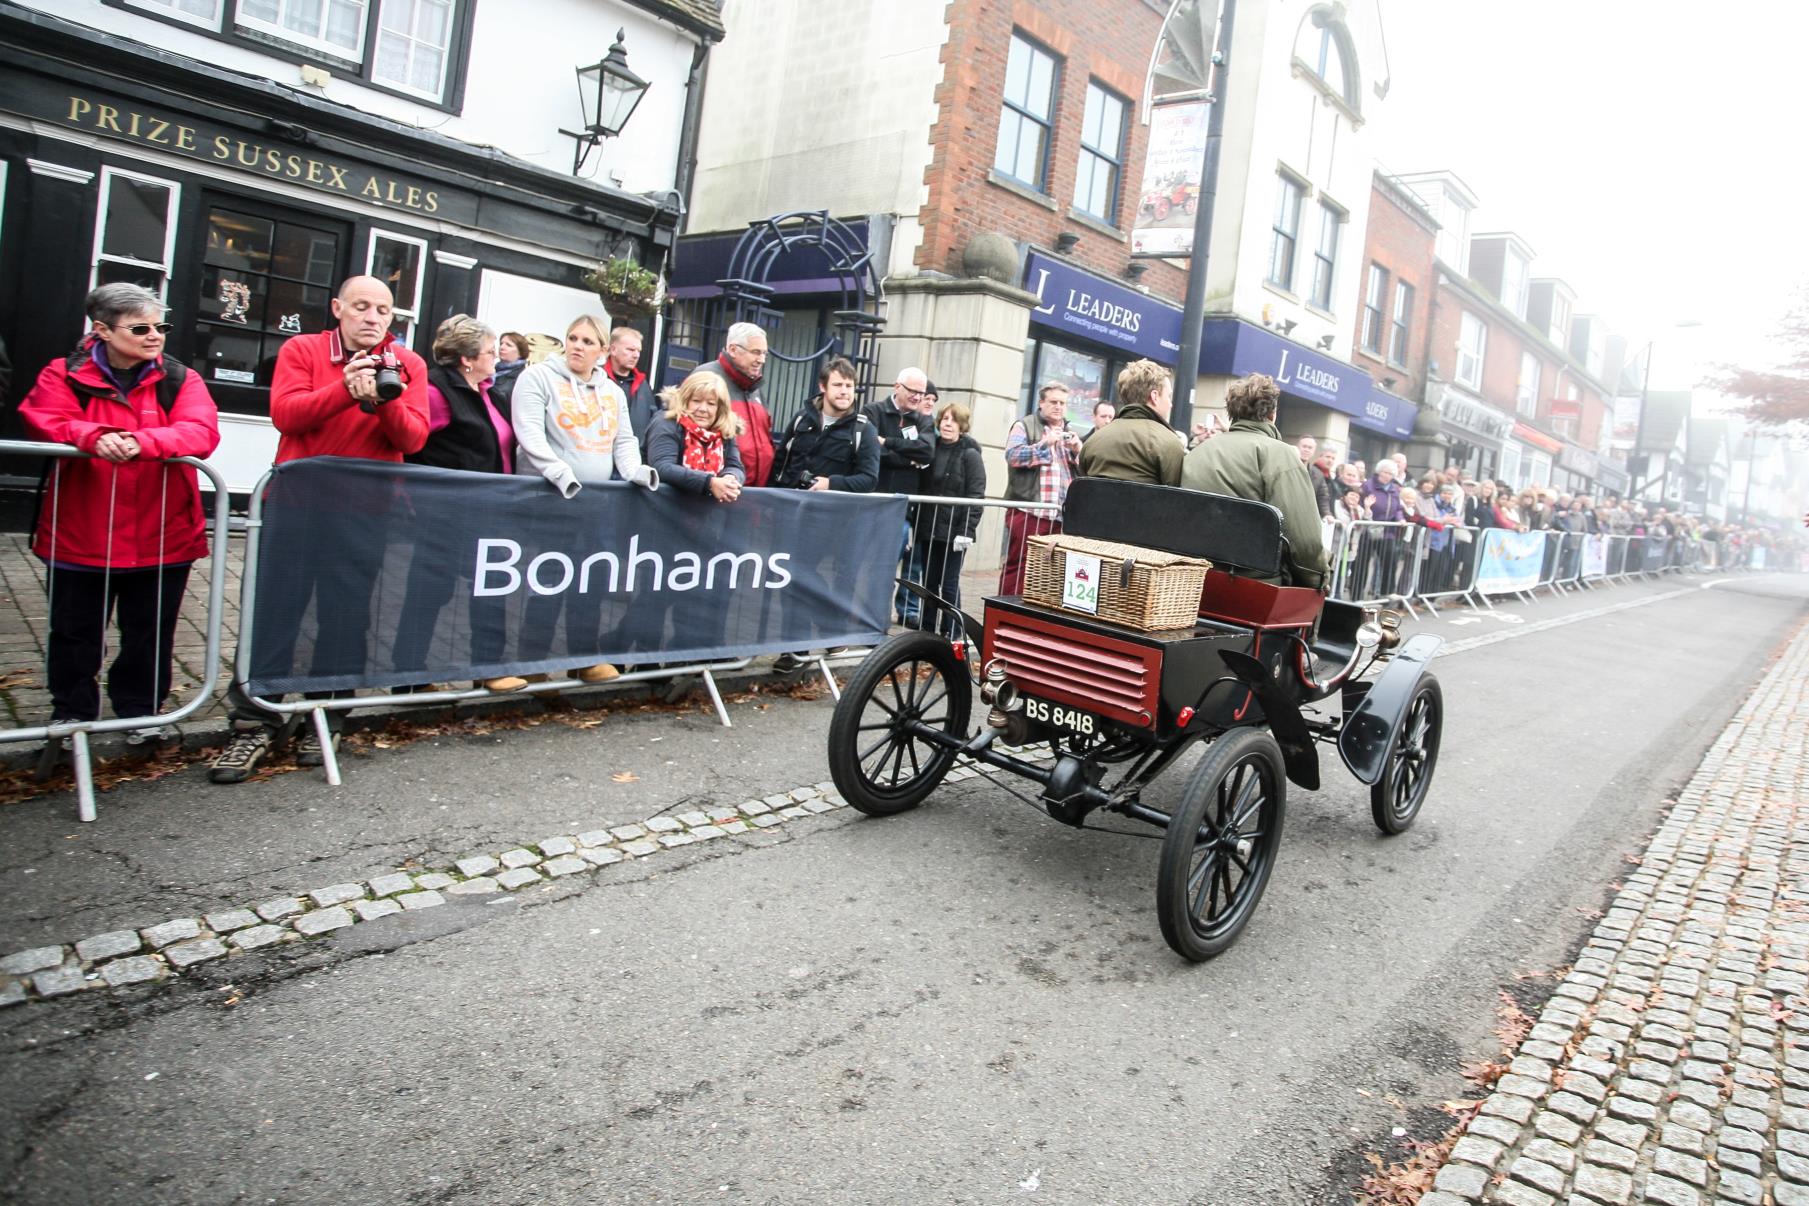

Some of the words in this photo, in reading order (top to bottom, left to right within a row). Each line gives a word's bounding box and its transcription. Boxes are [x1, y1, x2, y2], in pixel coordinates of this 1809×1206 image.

[67, 97, 197, 150] PRIZE
[213, 136, 348, 190] SUSSEX
[361, 176, 439, 212] ALES
[1067, 289, 1142, 332] LEADERS
[1276, 349, 1291, 384] L
[1296, 363, 1340, 393] LEADERS
[1365, 401, 1388, 420] ADERS
[473, 534, 792, 596] Bonhams
[1067, 581, 1096, 603] 124
[1026, 698, 1049, 721] BS
[1052, 707, 1094, 734] 8418
